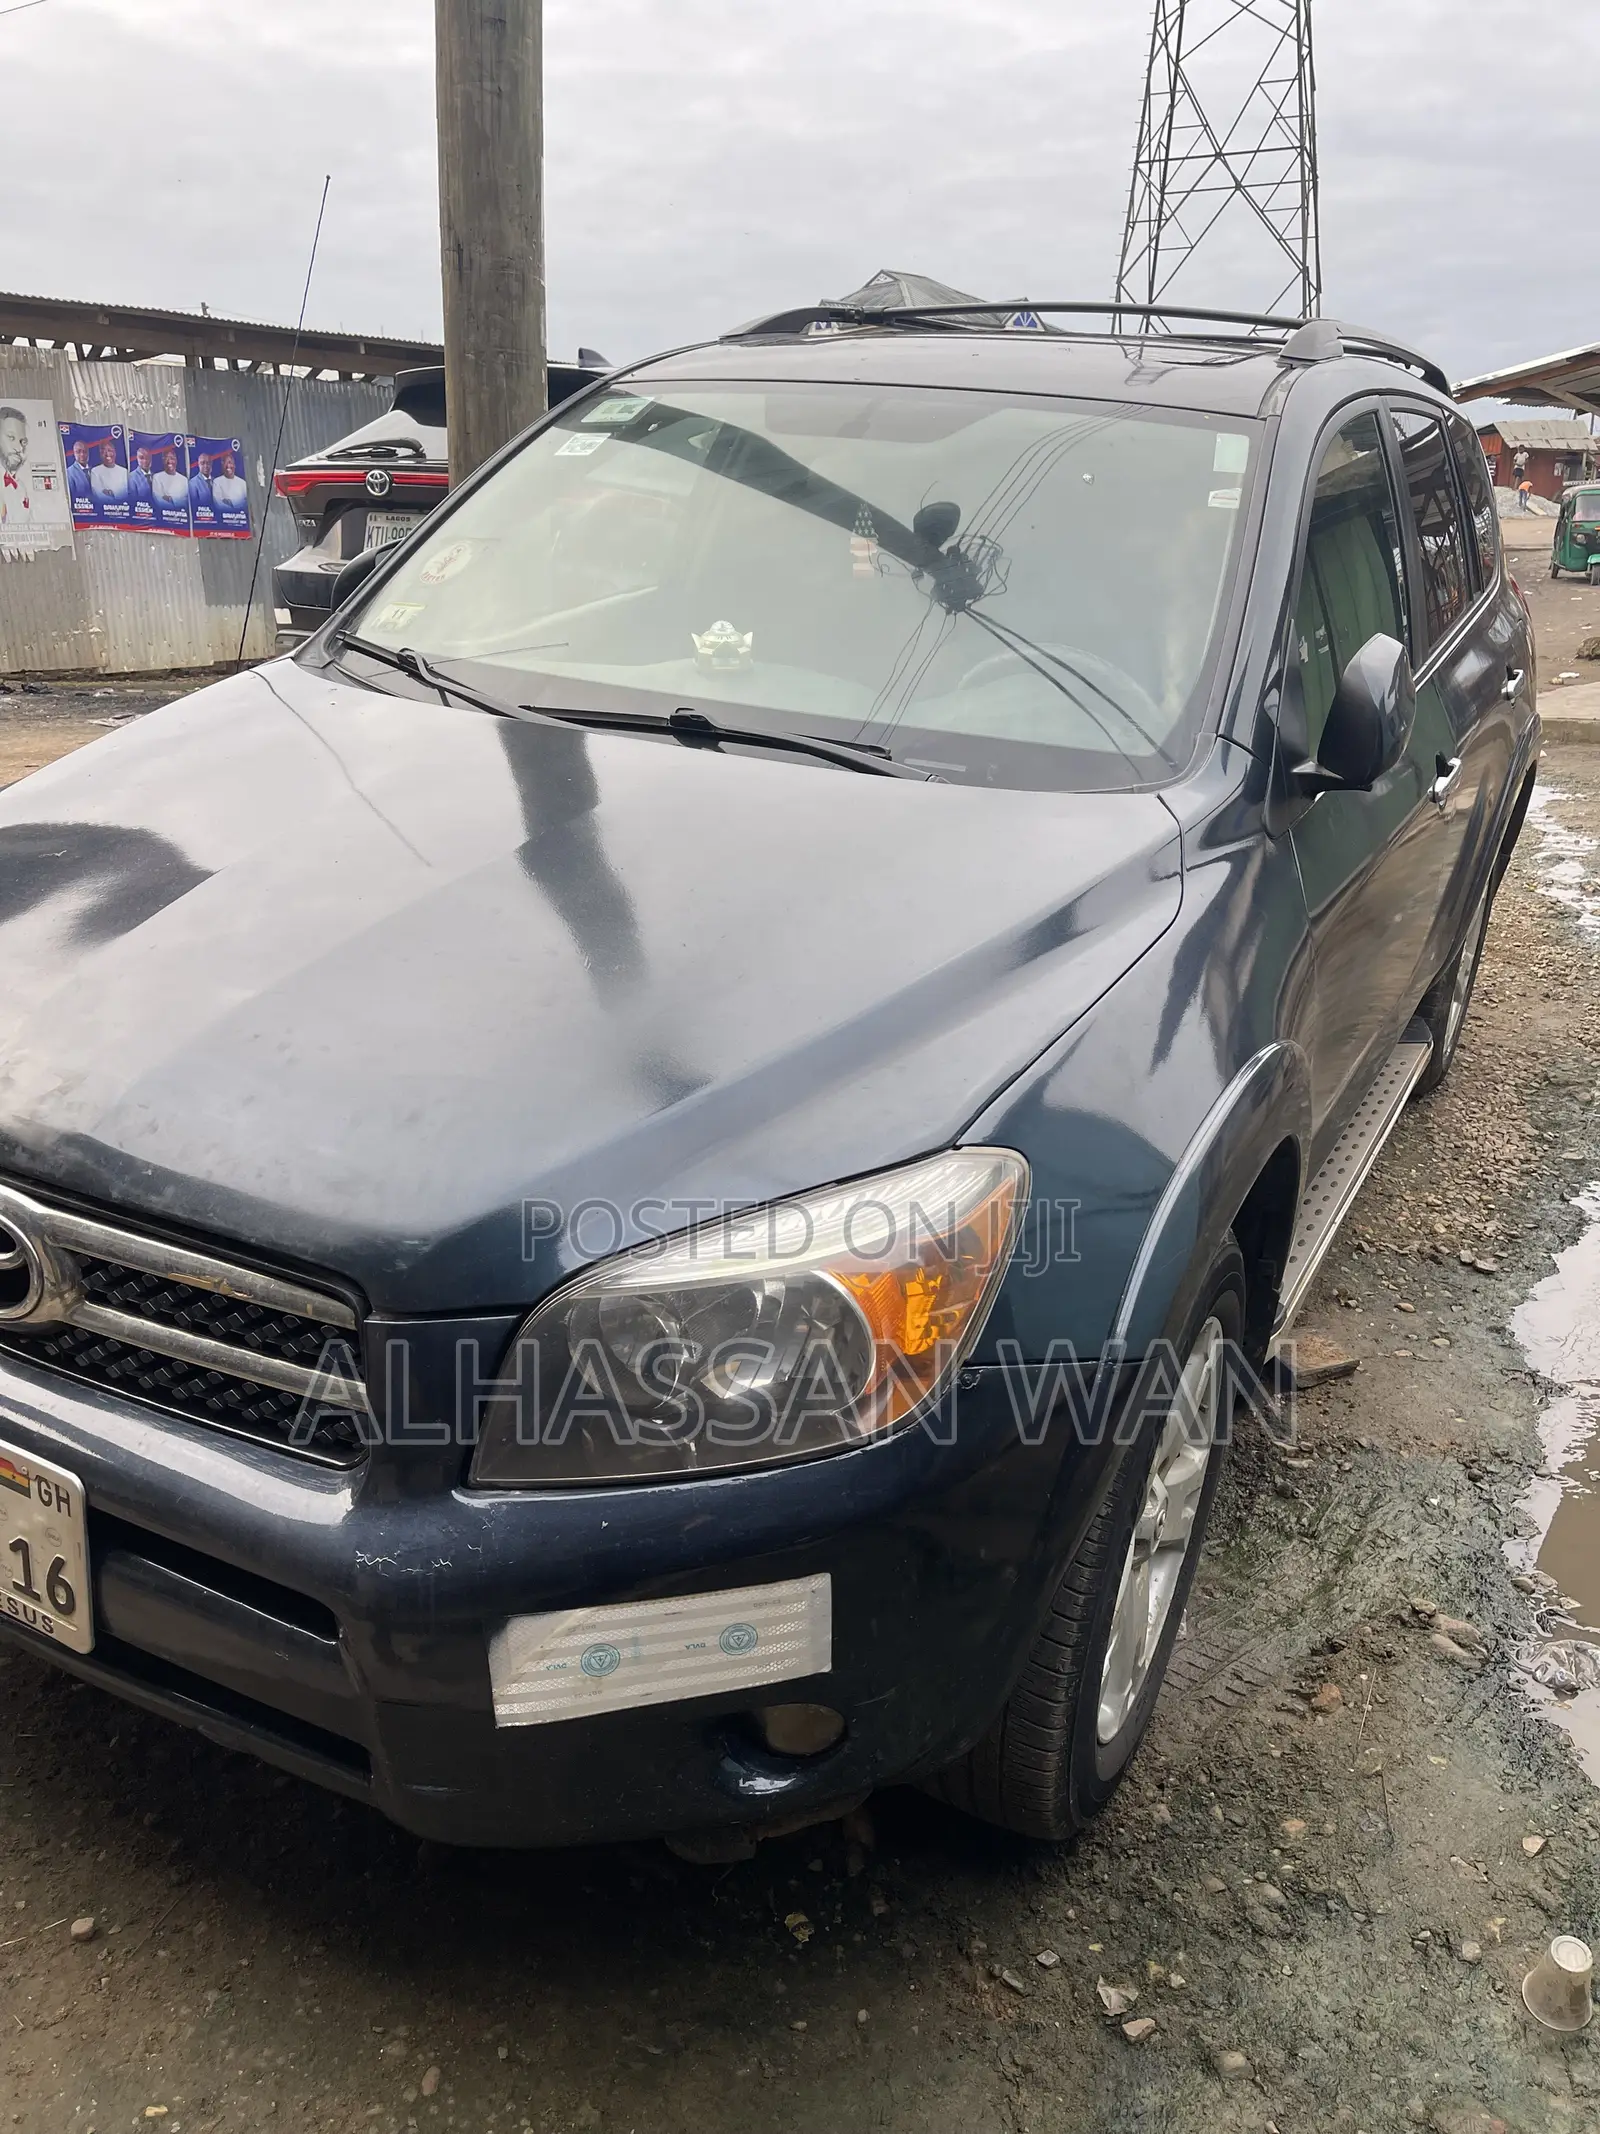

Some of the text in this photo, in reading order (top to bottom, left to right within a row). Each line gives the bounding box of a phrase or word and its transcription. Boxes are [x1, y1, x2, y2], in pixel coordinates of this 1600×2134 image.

[37, 1476, 72, 1518] GH
[9, 1534, 77, 1616] 16
[0, 1592, 54, 1634] SUS
